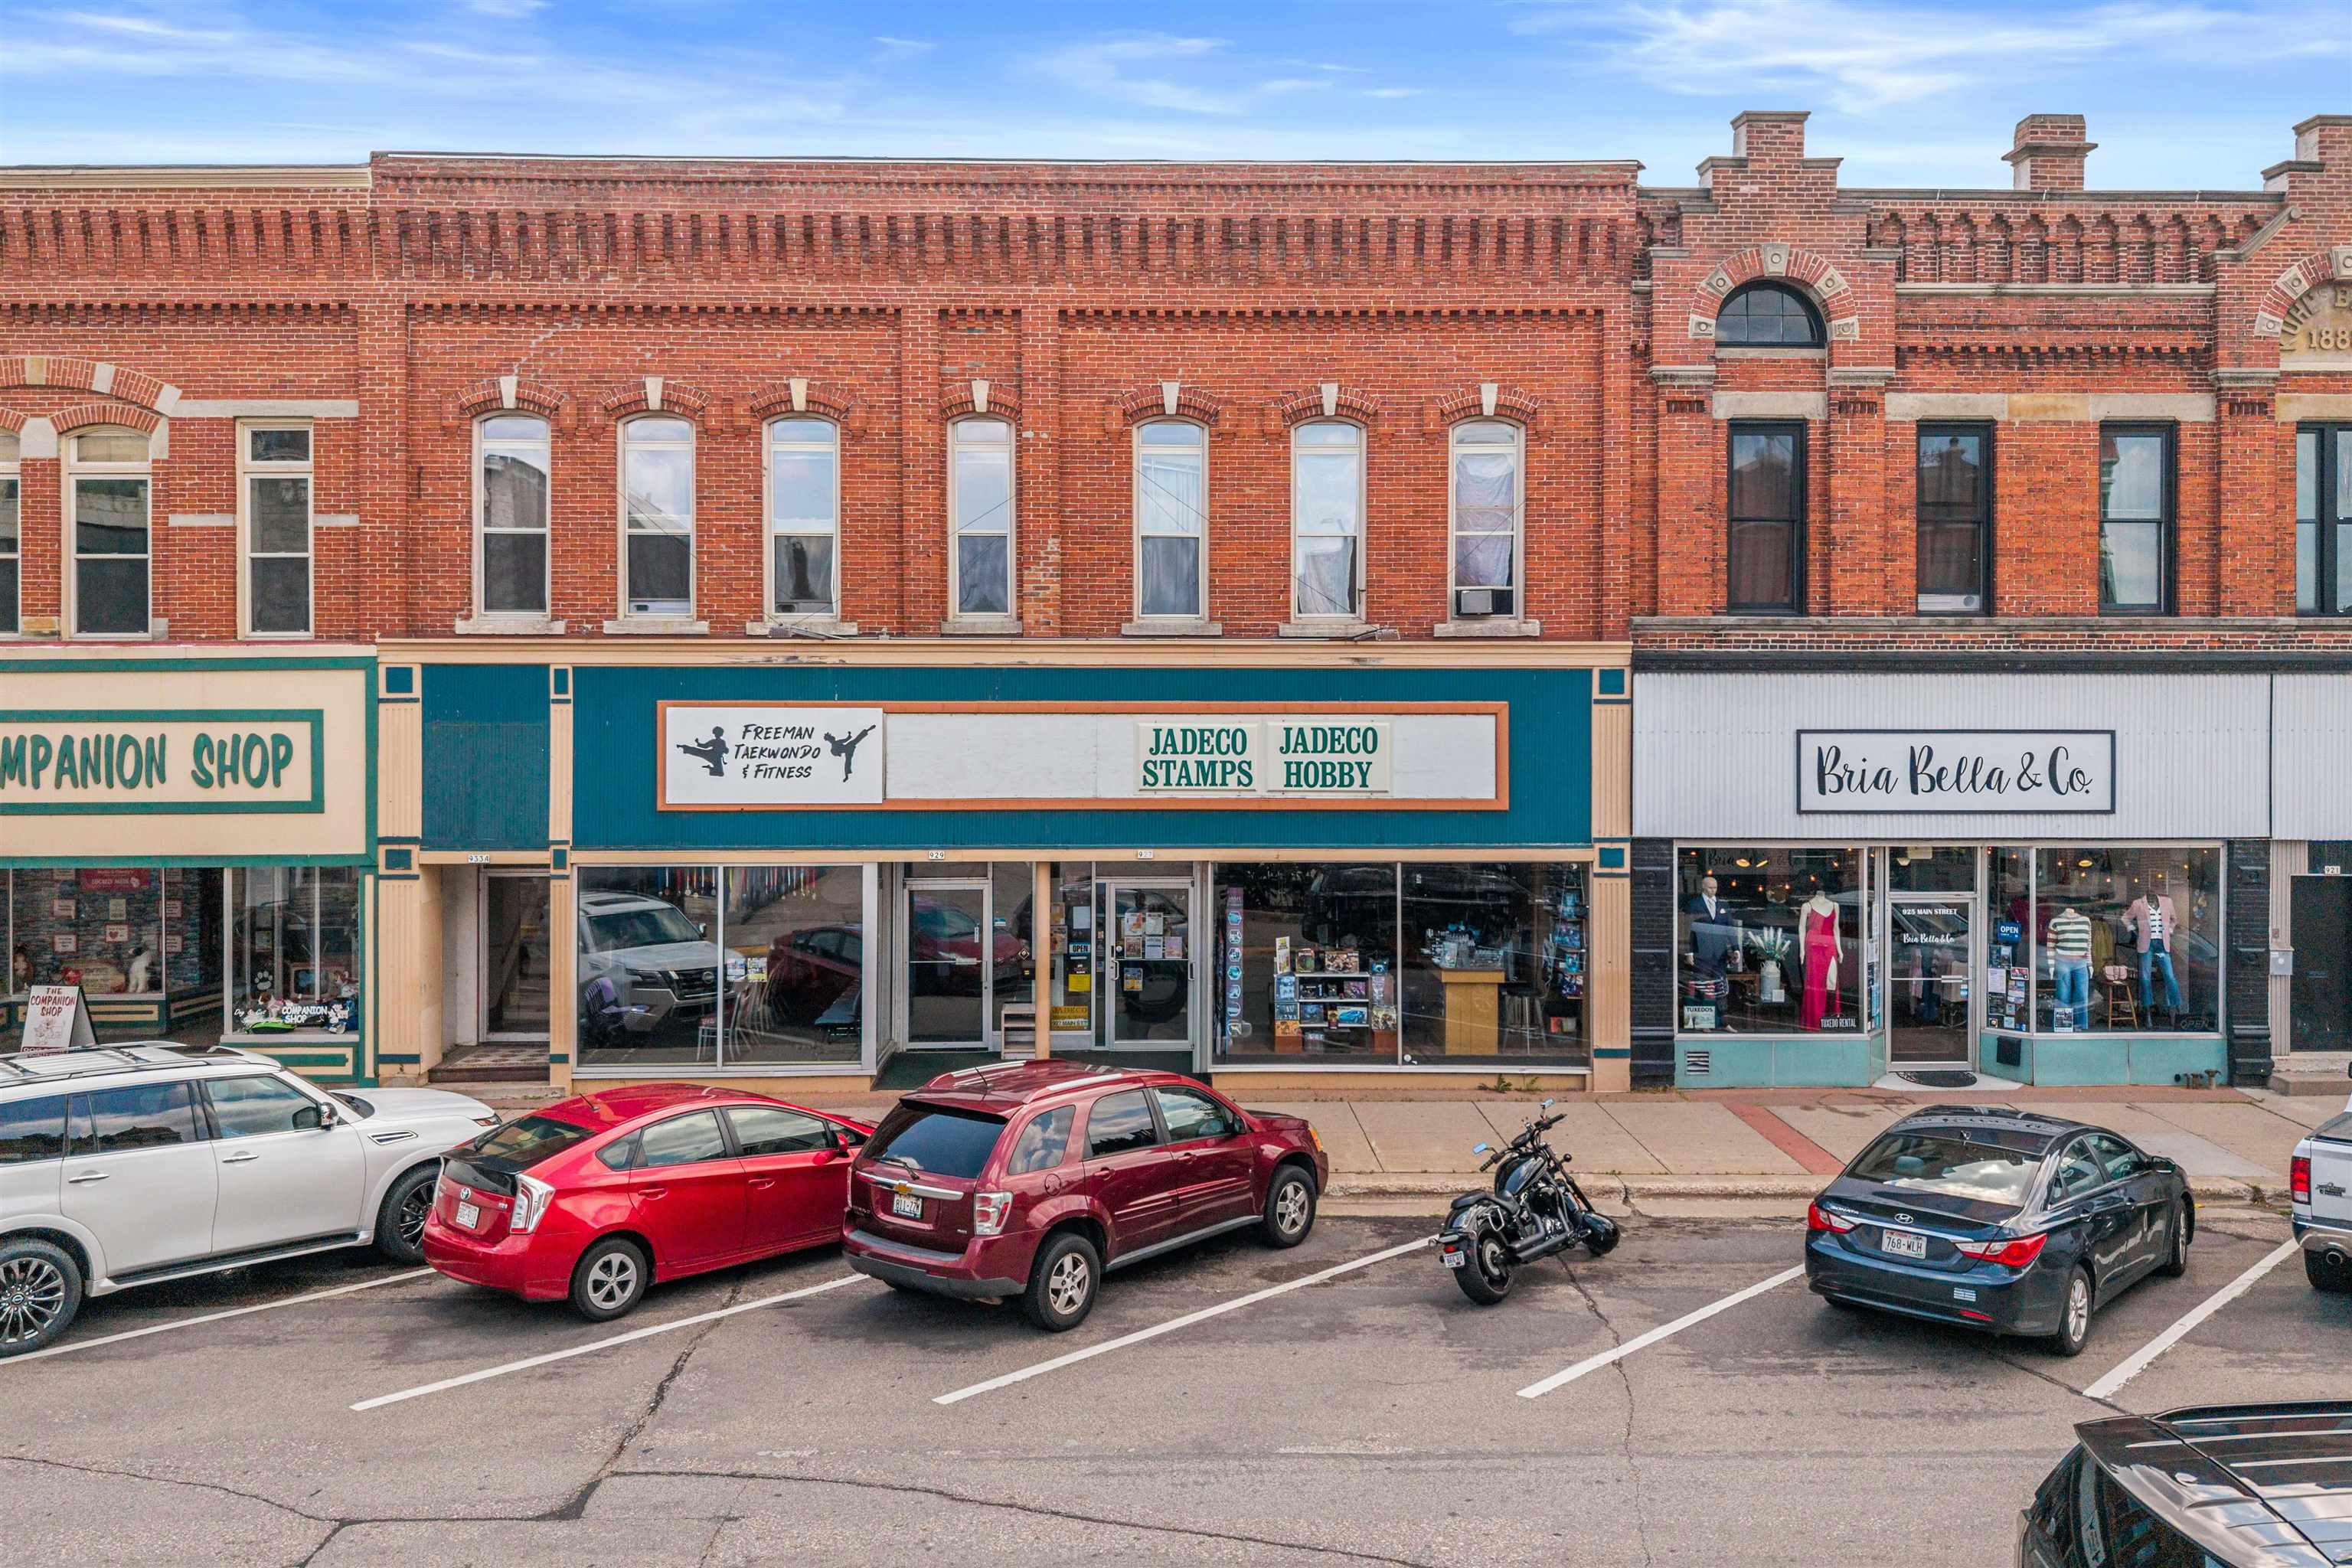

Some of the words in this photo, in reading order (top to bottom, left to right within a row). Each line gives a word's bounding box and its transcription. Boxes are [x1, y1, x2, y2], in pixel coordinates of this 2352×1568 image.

[2308, 327, 2352, 351] 188
[741, 724, 815, 741] FREEMAN
[1279, 727, 1378, 755] JADECO
[1148, 727, 1248, 756] JADECO
[734, 743, 822, 760] TAEKWONDO
[191, 733, 294, 789] SHOP
[742, 763, 750, 779] &
[753, 763, 812, 779] FITNESS
[1142, 760, 1253, 788] STAMPS
[1283, 760, 1373, 789] HOBBY
[1817, 744, 1899, 796] Bria
[1909, 744, 2011, 796] Bella
[2017, 751, 2043, 792] &
[2048, 745, 2093, 796] Co.
[2000, 925, 2019, 934] OPEN
[1903, 933, 1919, 944] Bria
[1920, 933, 1939, 944] Bella
[1072, 944, 1089, 953] OPEN
[31, 995, 76, 1006] COMPANION
[40, 1007, 63, 1017] SHOP
[281, 1006, 328, 1015] COMPANION
[1821, 1018, 1838, 1028] TUXEDO
[1839, 1018, 1856, 1027] RENTAL
[2180, 1017, 2210, 1029] OPEN
[1886, 1236, 1922, 1253] 768-WLH
